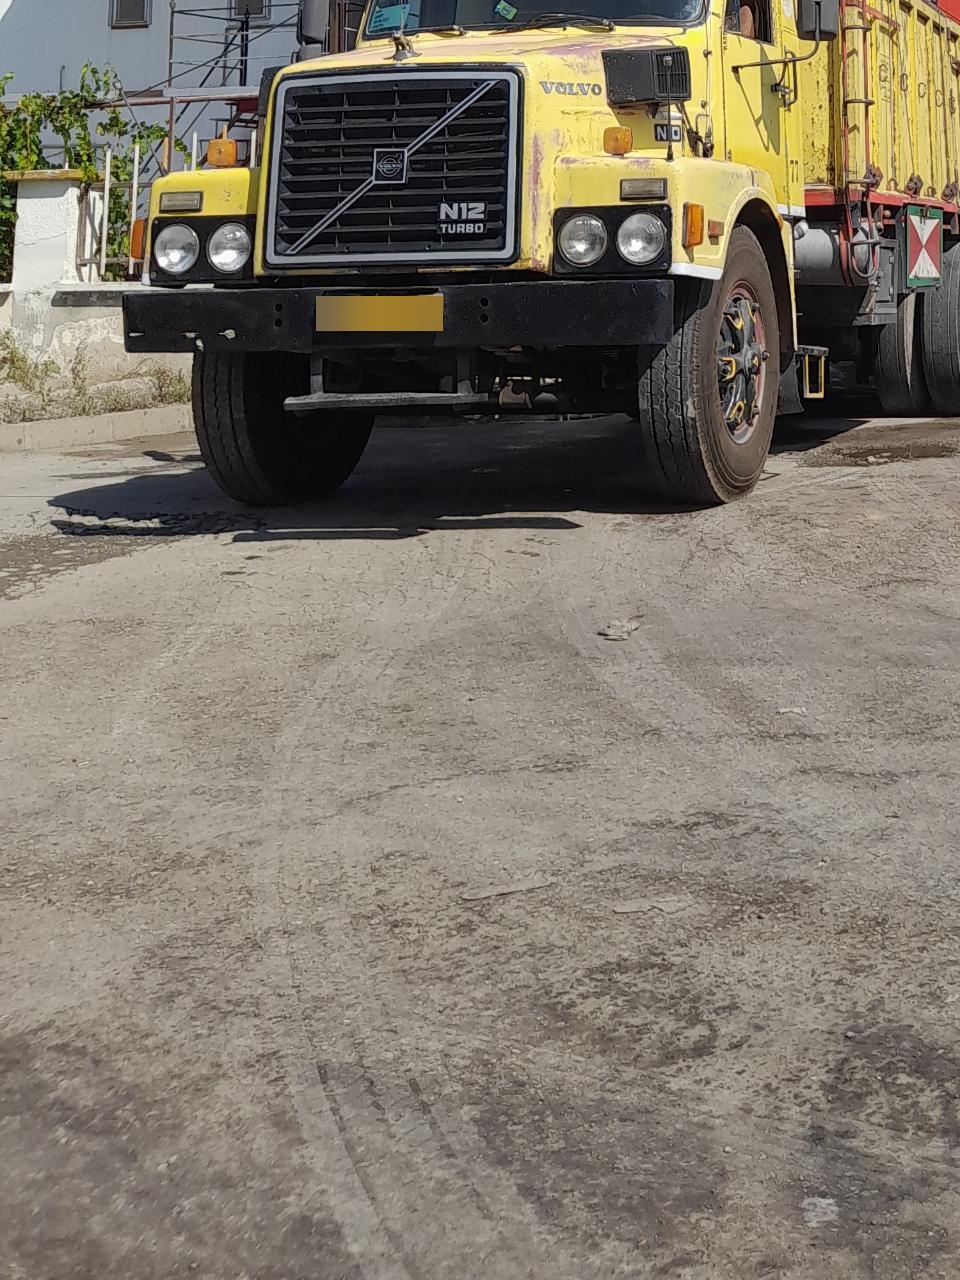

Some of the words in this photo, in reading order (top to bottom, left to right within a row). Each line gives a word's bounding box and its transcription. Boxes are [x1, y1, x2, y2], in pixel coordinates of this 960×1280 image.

[539, 80, 602, 96] VOLVO
[440, 202, 485, 220] N12
[440, 223, 484, 233] TURBO
